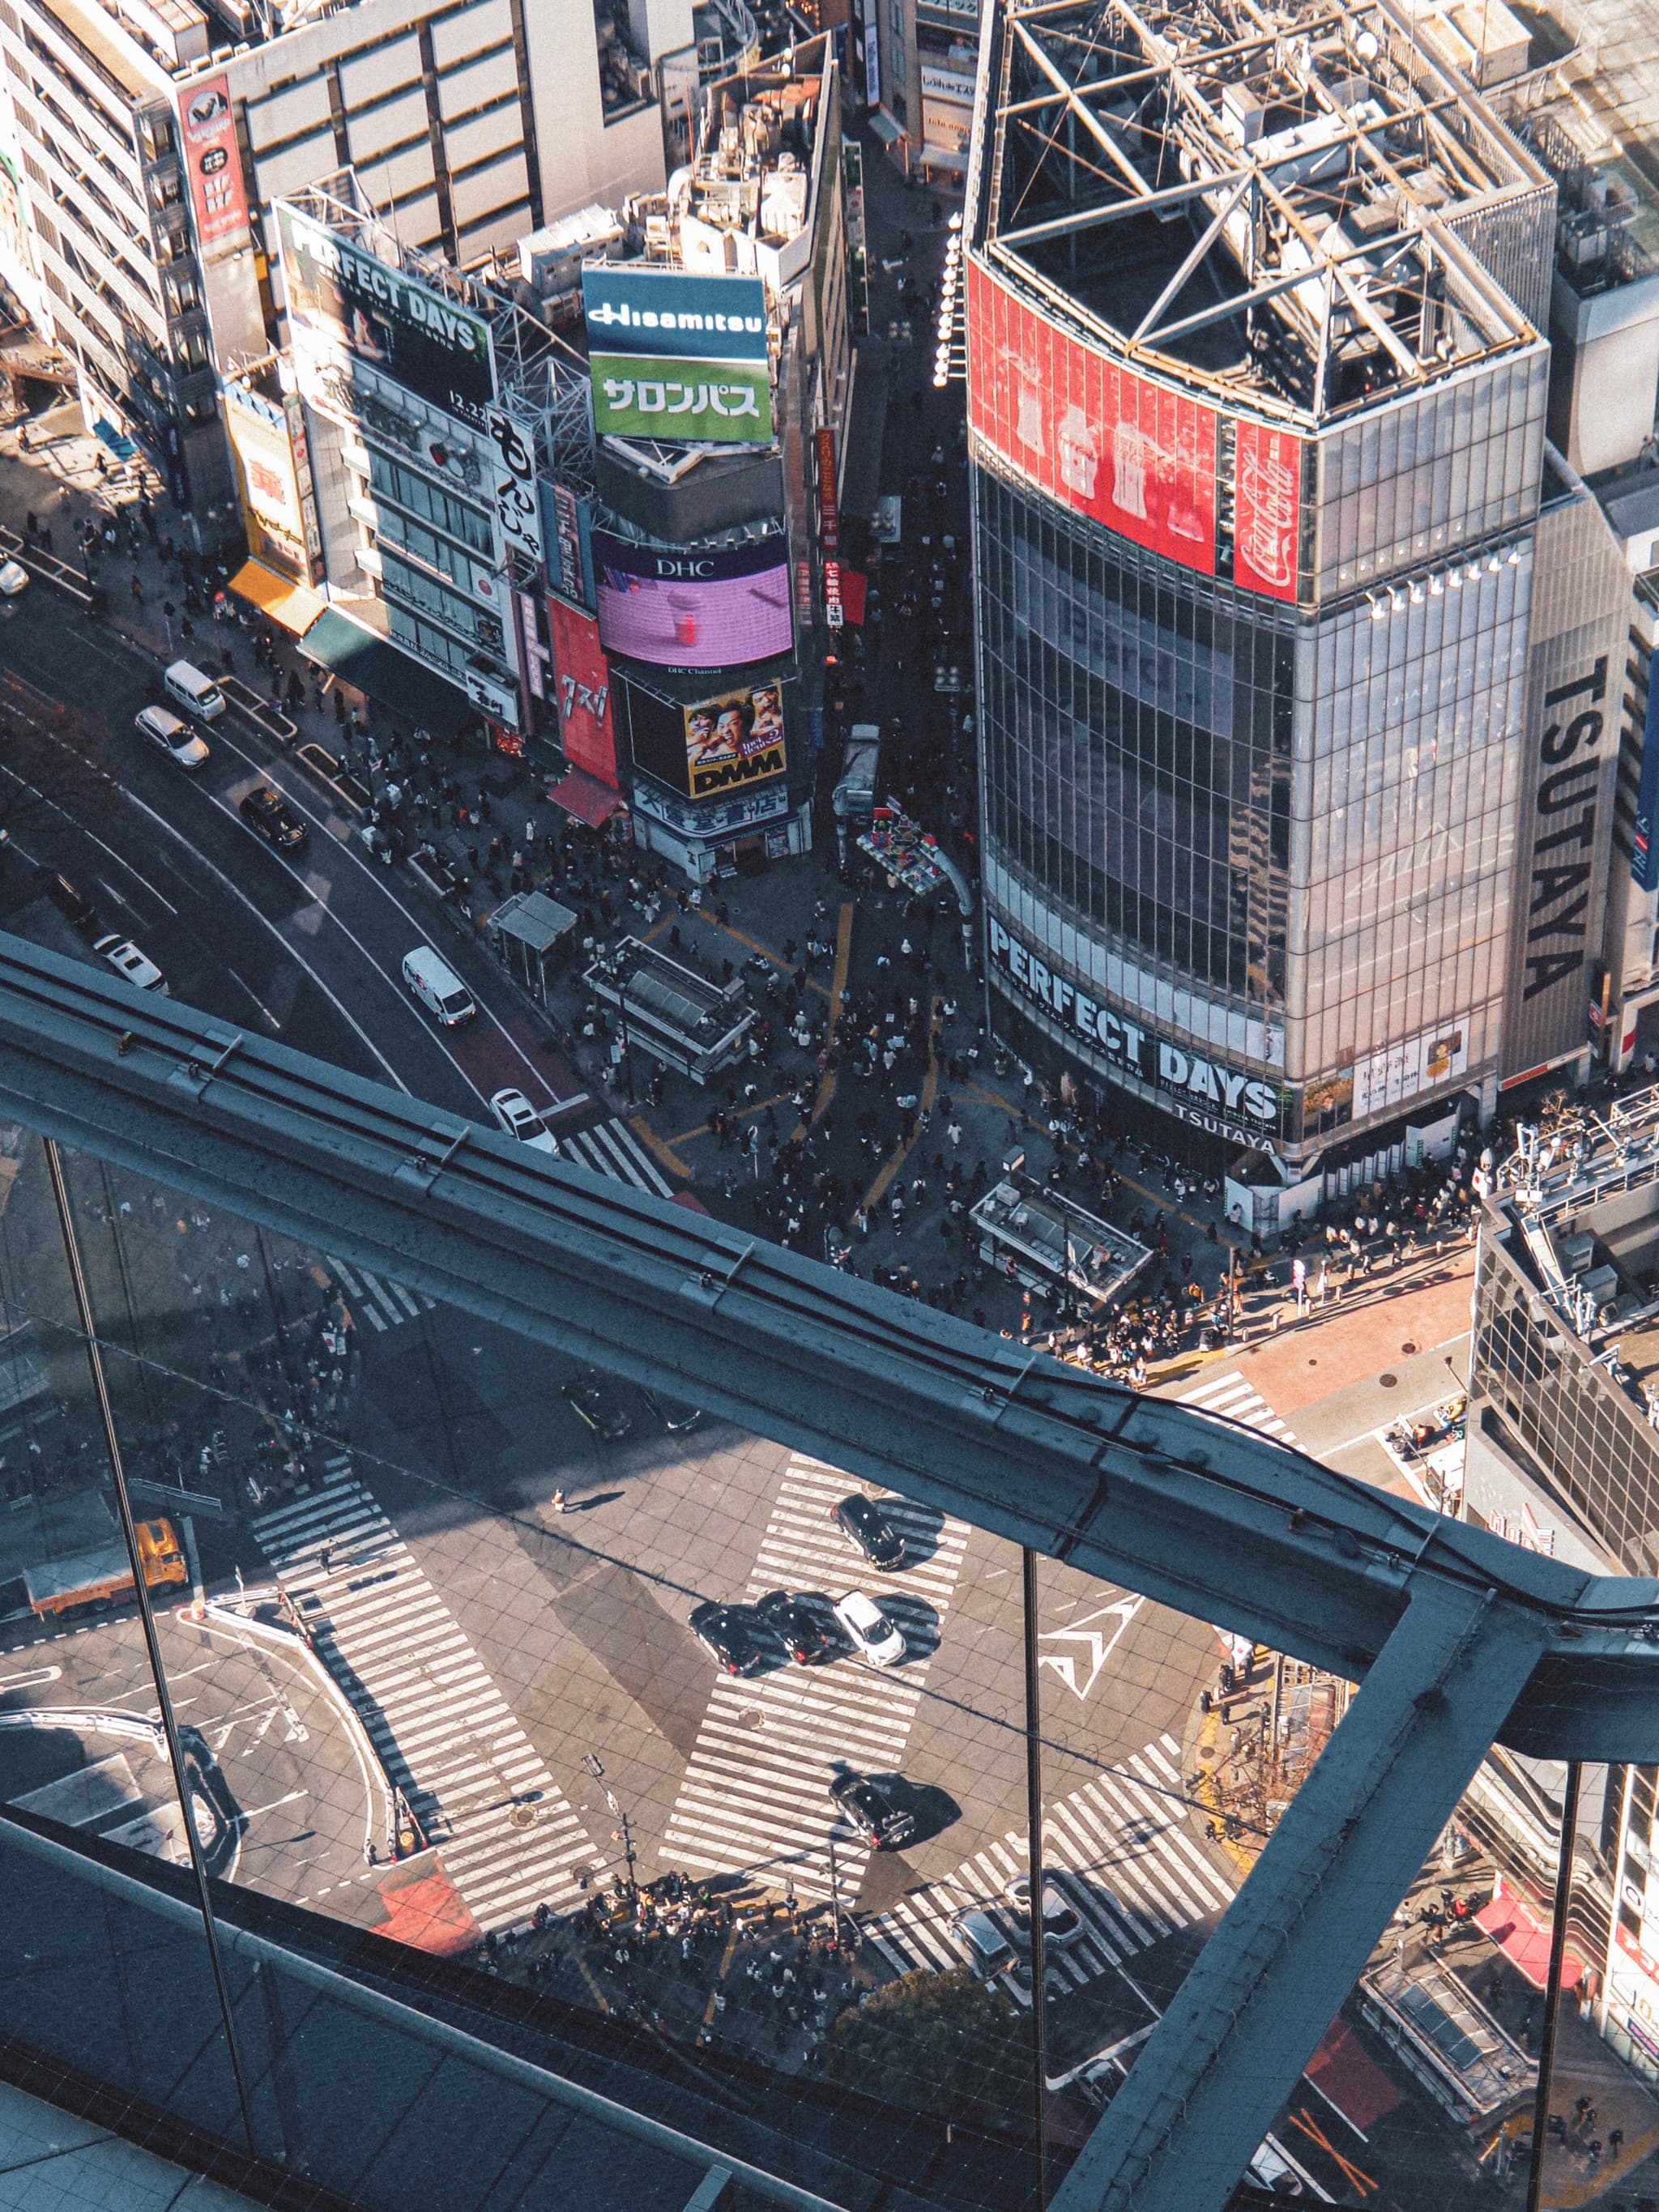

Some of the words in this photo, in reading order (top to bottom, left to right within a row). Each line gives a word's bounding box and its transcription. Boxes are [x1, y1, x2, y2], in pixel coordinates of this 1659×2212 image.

[292, 219, 400, 309] PERFECT
[408, 289, 476, 351] DAYS
[588, 303, 762, 333] Hisamitsu
[450, 390, 487, 422] 12.22
[603, 377, 761, 418] サロンパス
[656, 559, 715, 577] DHC
[667, 667, 687, 675] DHC
[689, 667, 722, 676] Channel
[694, 748, 783, 795] DMM
[1523, 654, 1608, 1003] TSUTAYA
[990, 916, 1145, 1063] PERFECT
[1160, 1042, 1277, 1119] DAYS
[1175, 1103, 1276, 1156] TSUTAYA
